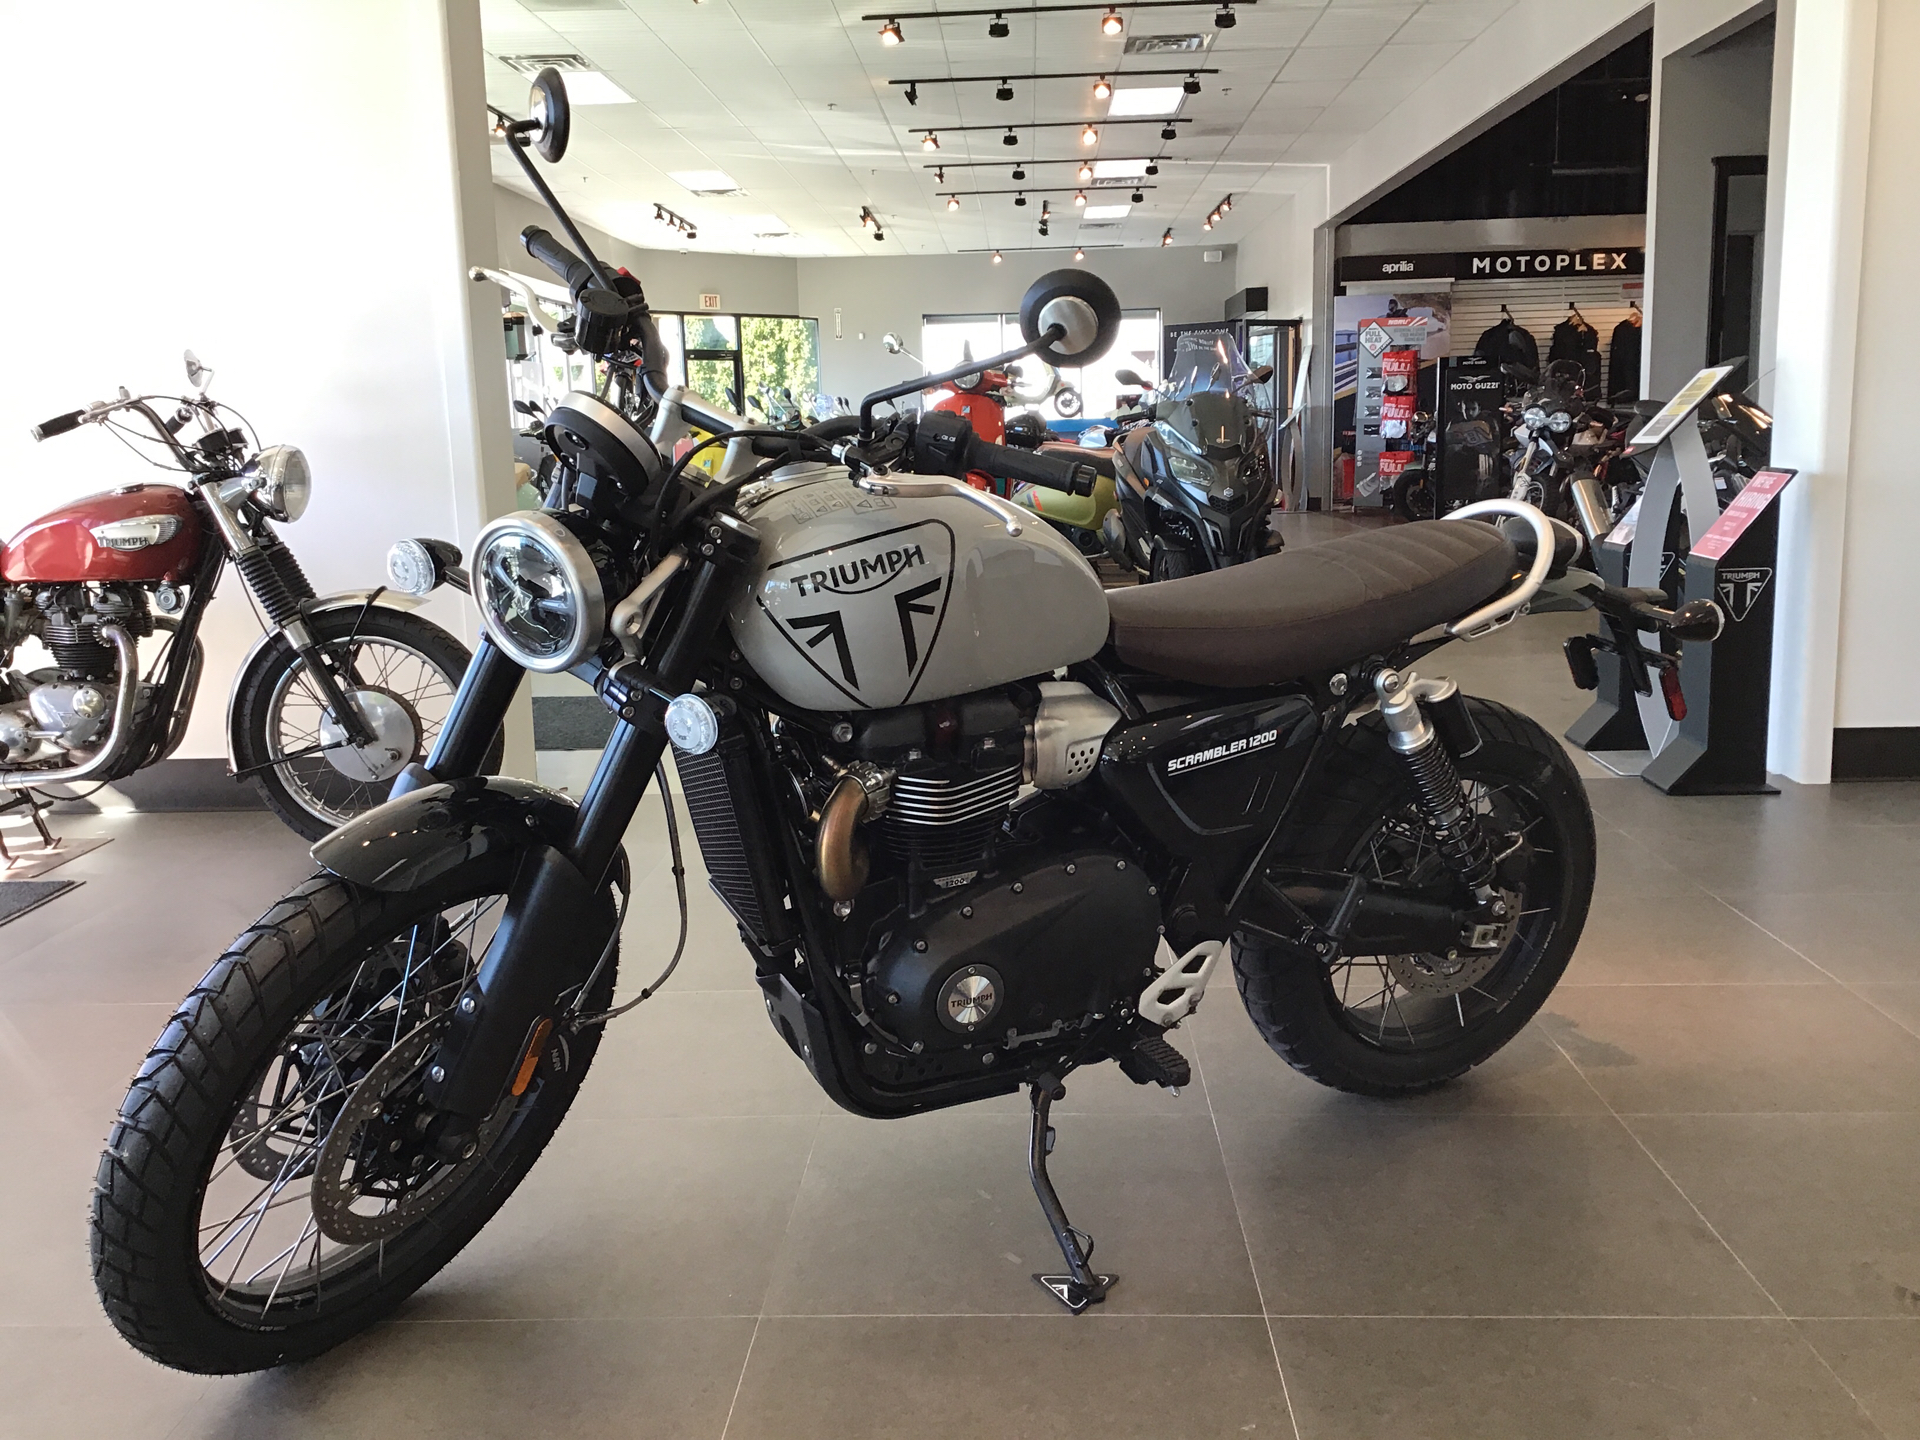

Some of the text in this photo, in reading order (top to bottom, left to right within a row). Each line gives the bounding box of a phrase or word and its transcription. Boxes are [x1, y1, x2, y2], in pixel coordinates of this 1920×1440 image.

[1382, 260, 1414, 275] aprilia
[1472, 253, 1627, 274] MOTOPLEX
[704, 295, 718, 308] EXIT
[1474, 382, 1499, 390] GUZZI
[1734, 491, 1772, 509] HIRING
[97, 535, 149, 548] TRIUMPH
[789, 544, 926, 598] TRIUMPH
[1721, 571, 1761, 581] TRIUMPH
[1167, 729, 1278, 773] SCRAMBLER 1200
[945, 877, 966, 888] 1200
[950, 992, 994, 1009] TRIUMPH
